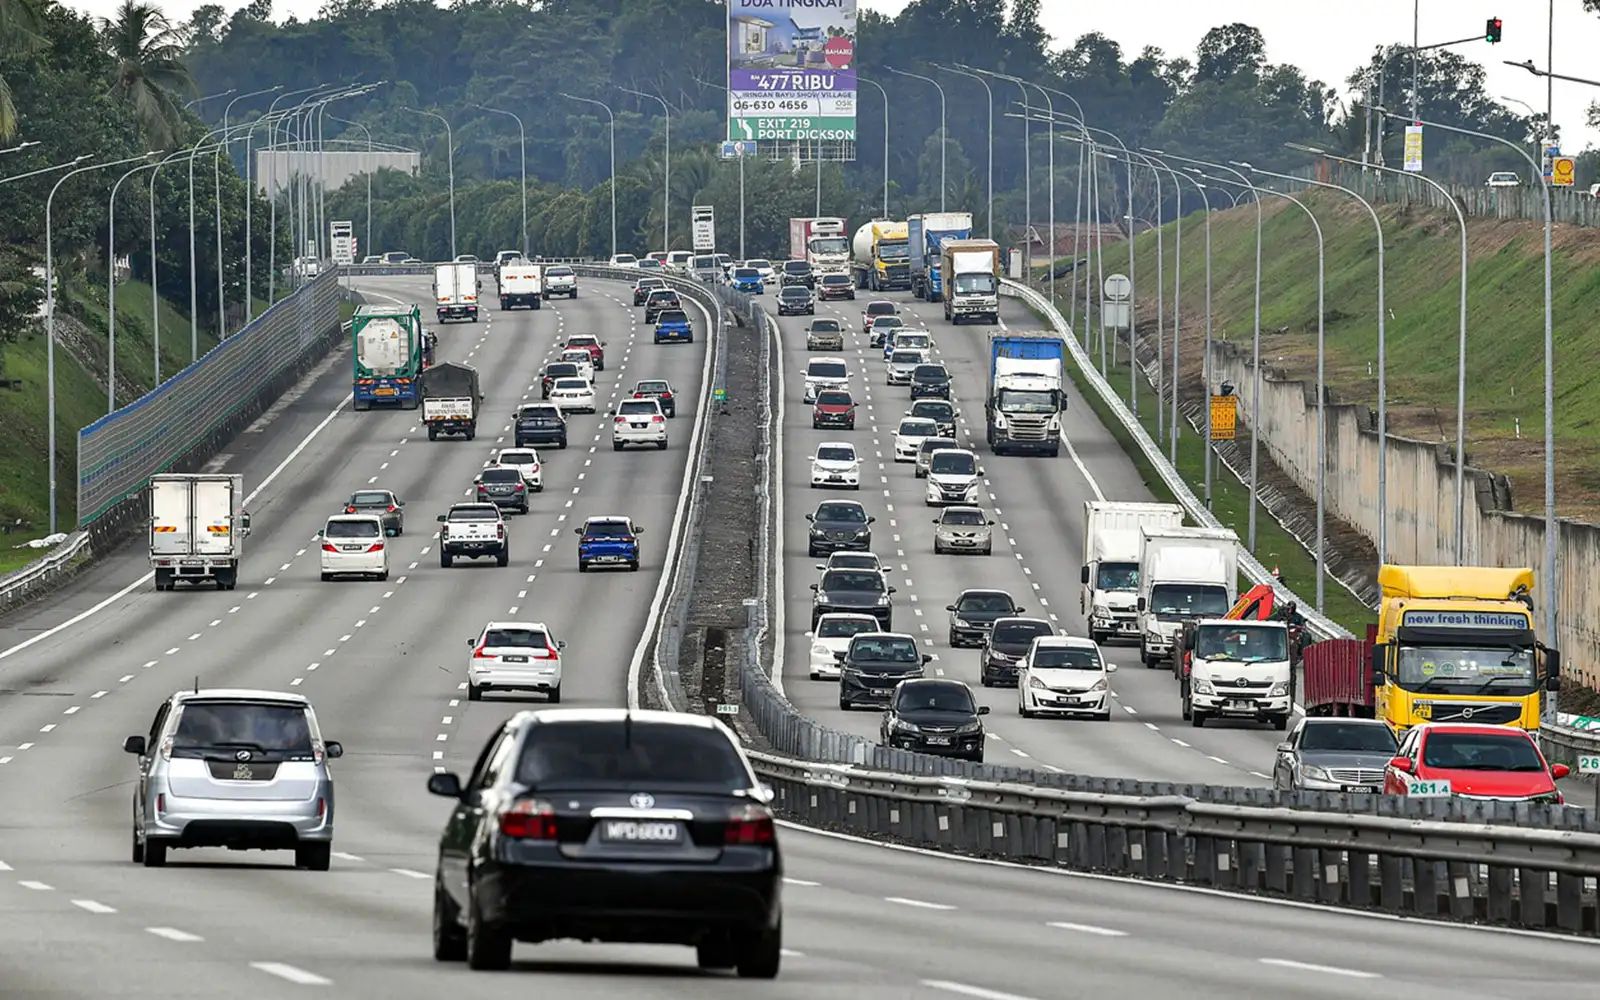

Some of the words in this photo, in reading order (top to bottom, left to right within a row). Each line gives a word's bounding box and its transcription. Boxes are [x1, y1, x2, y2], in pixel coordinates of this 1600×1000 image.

[758, 75, 789, 90] 477
[792, 75, 834, 90] RIBU
[734, 100, 775, 110] 06-630
[778, 100, 808, 110] 4656
[758, 119, 786, 128] EXIT
[790, 119, 810, 128] 219
[758, 130, 792, 140] PORT
[796, 130, 854, 140] DICKSON
[1408, 616, 1434, 624] new
[1438, 614, 1470, 624] fresh
[1474, 615, 1525, 628] thinking
[1411, 783, 1448, 794] 261.4
